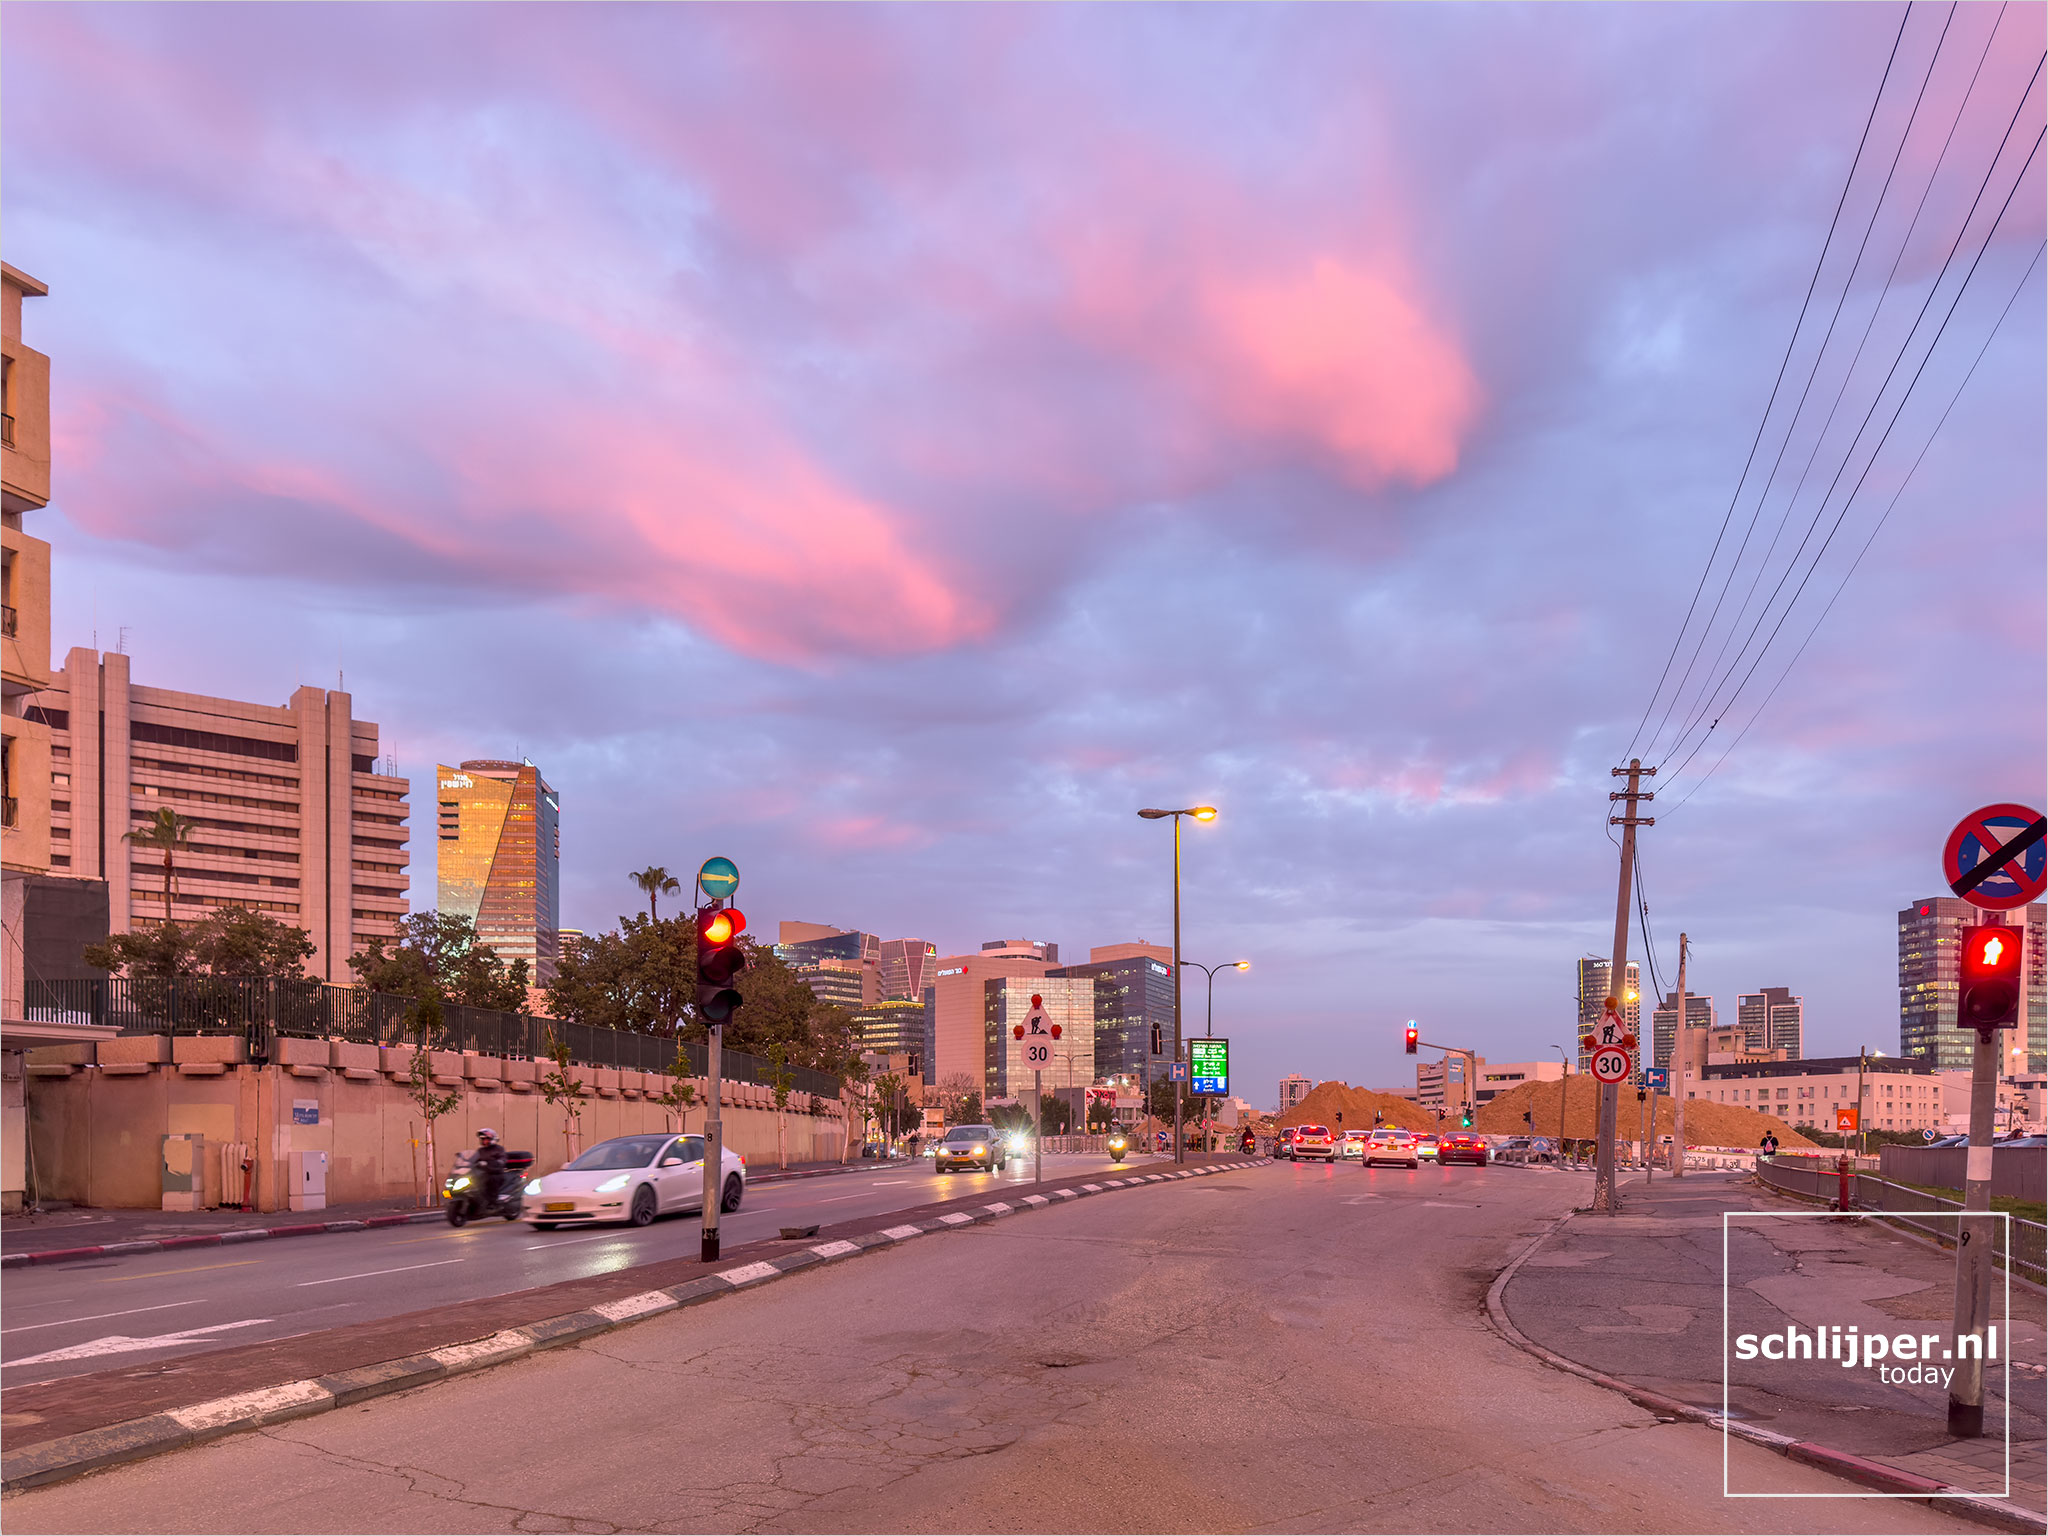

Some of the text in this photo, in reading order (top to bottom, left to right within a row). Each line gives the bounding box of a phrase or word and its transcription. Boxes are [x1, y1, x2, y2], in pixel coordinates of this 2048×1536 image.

[1029, 1046, 1047, 1061] 30
[1599, 1057, 1622, 1074] 30
[707, 1133, 713, 1142] 8
[1961, 1231, 1971, 1246] 9
